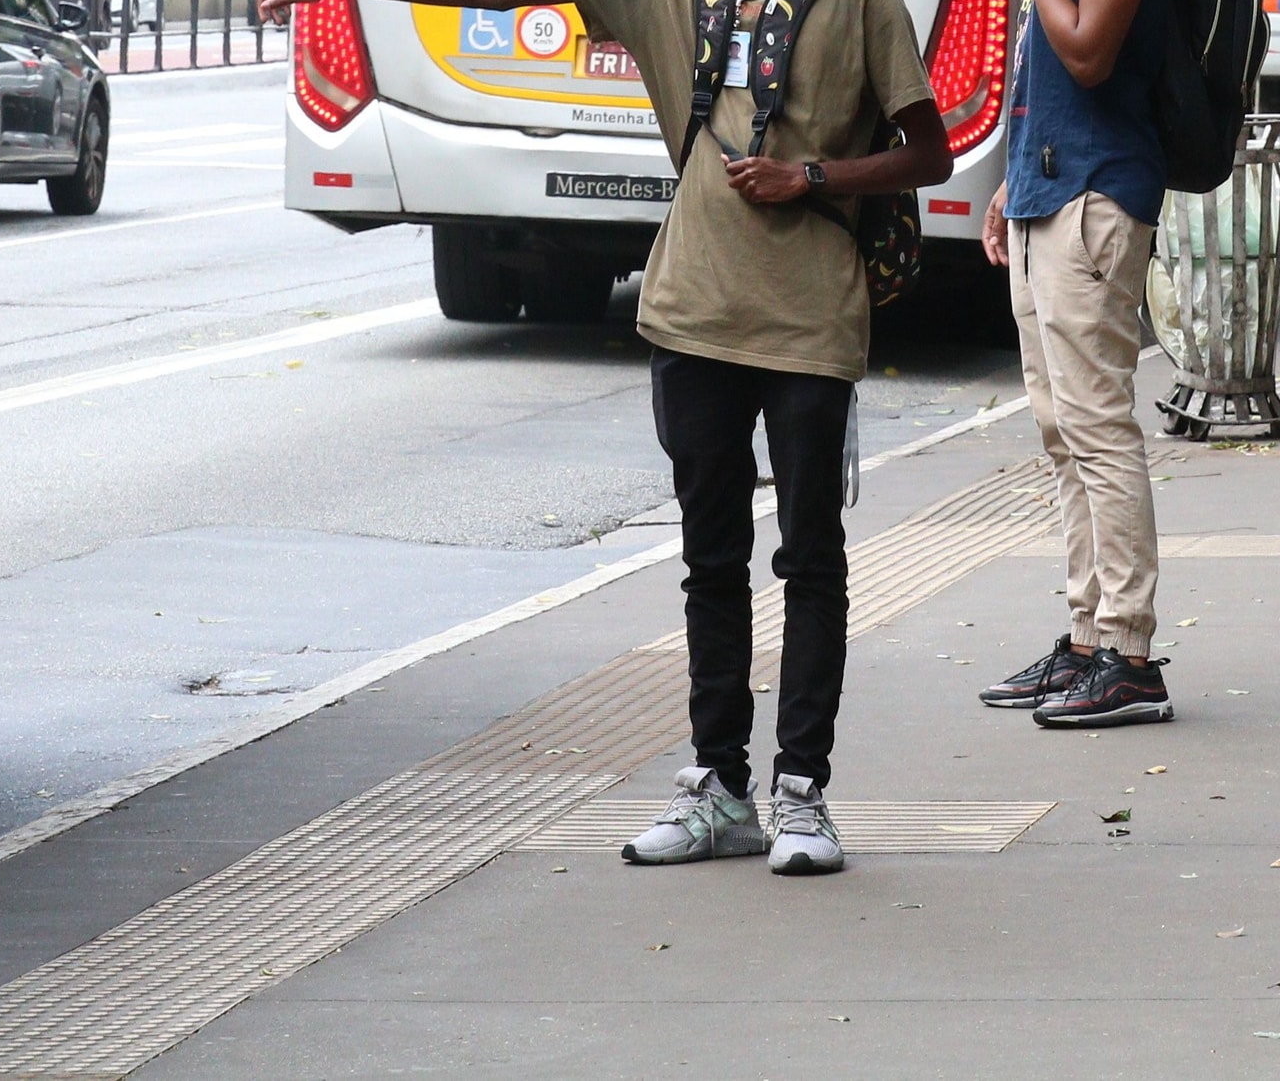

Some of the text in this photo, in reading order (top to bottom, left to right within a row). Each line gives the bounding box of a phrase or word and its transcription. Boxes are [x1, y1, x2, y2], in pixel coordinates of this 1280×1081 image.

[534, 22, 554, 38] 50
[589, 52, 640, 74] FRI-
[572, 109, 644, 125] Mantenha
[555, 175, 675, 199] Mercedes-B
